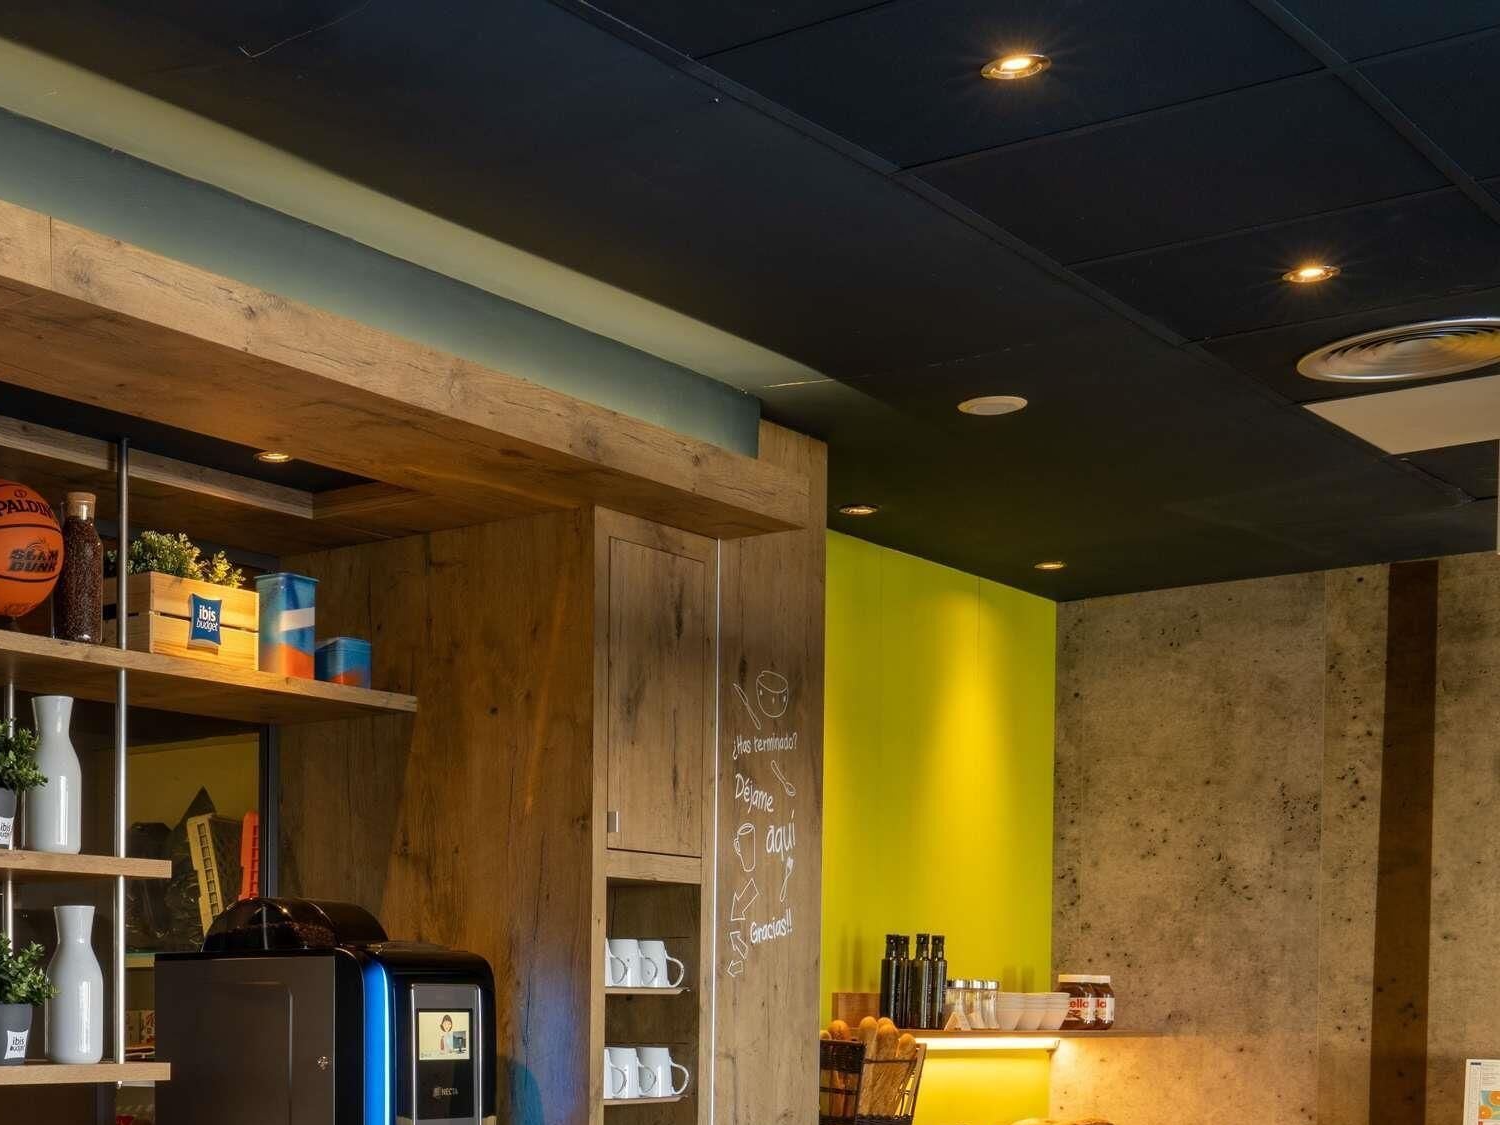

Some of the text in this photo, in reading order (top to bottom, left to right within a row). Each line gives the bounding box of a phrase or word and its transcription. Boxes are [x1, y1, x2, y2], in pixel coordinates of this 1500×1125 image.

[199, 604, 217, 621] ibis
[196, 617, 219, 632] budget
[753, 732, 798, 753] terminado?
[735, 773, 774, 814] Déjame
[765, 808, 796, 862] aquí
[750, 908, 793, 945] Gracias!!
[12, 1035, 25, 1046] ibis
[441, 1087, 459, 1096] NECTA
